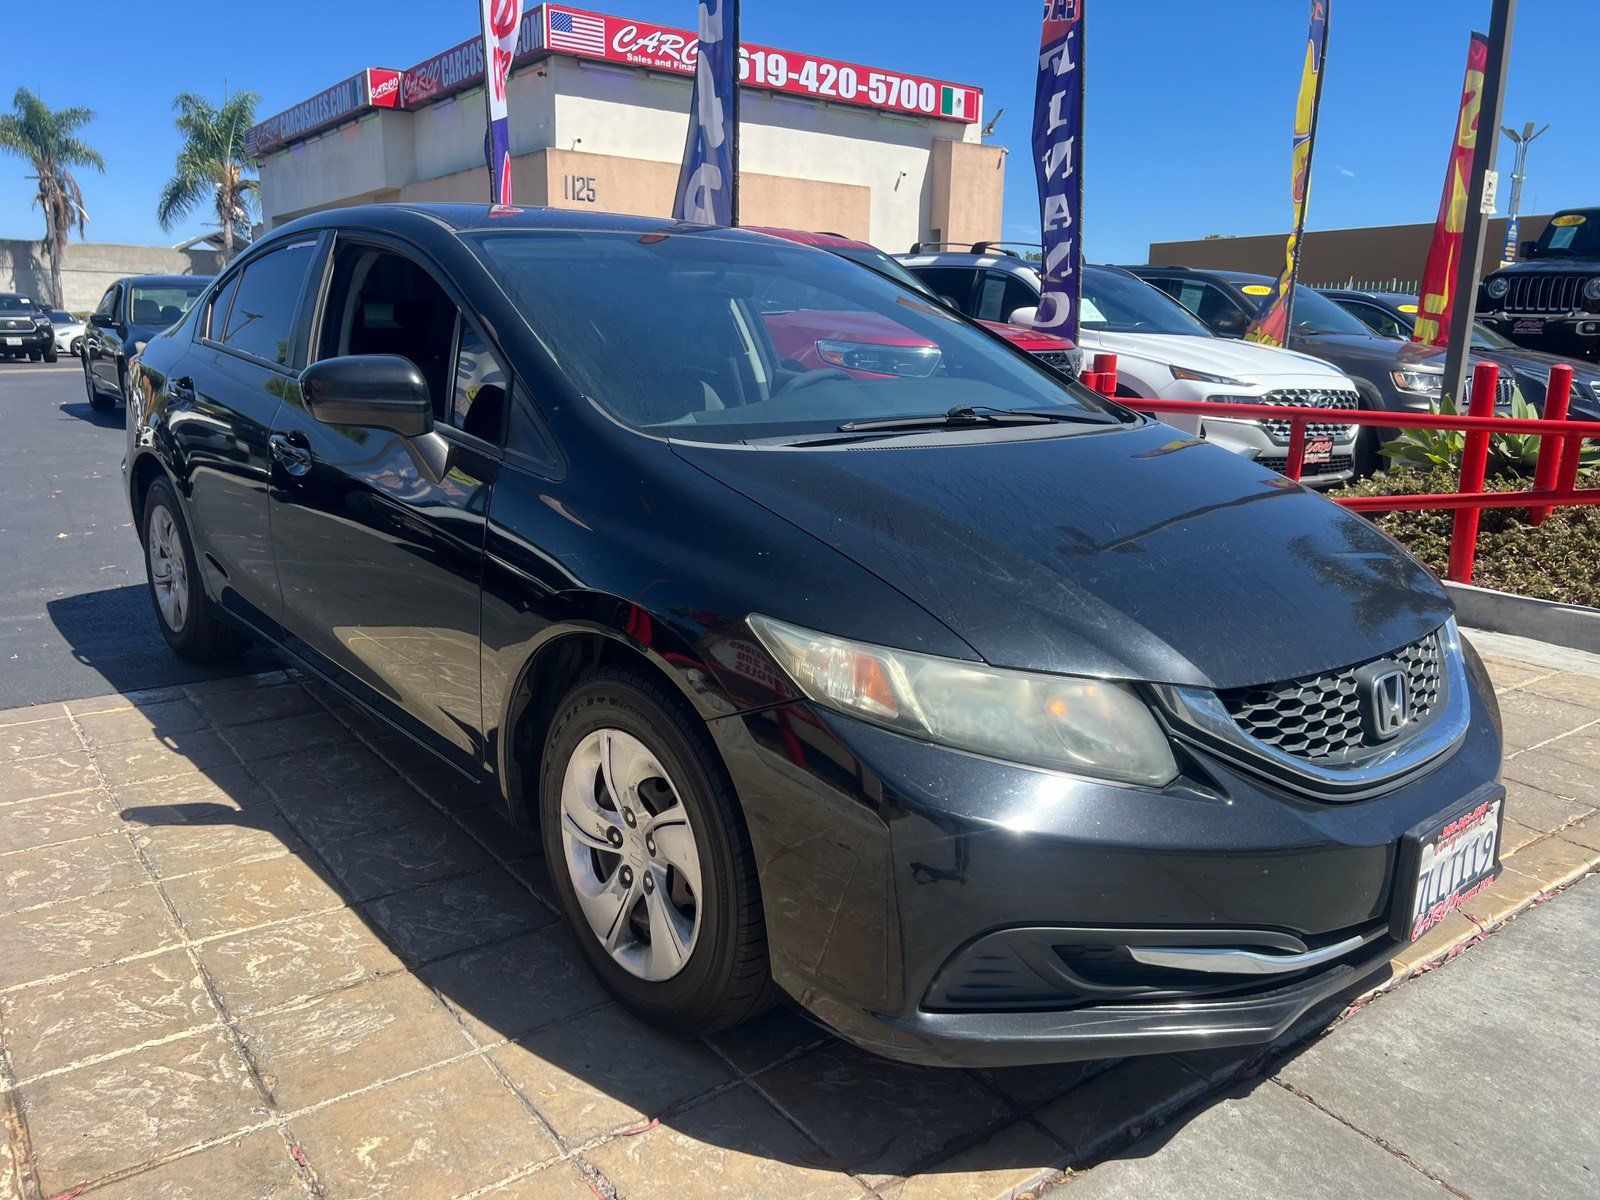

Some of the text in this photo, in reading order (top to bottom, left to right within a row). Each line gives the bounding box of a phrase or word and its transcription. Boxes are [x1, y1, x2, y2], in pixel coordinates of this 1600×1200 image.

[612, 25, 698, 65] CARC
[626, 52, 652, 64] Sales
[654, 59, 671, 68] and
[371, 77, 399, 98] CARCO
[564, 174, 596, 203] 1125
